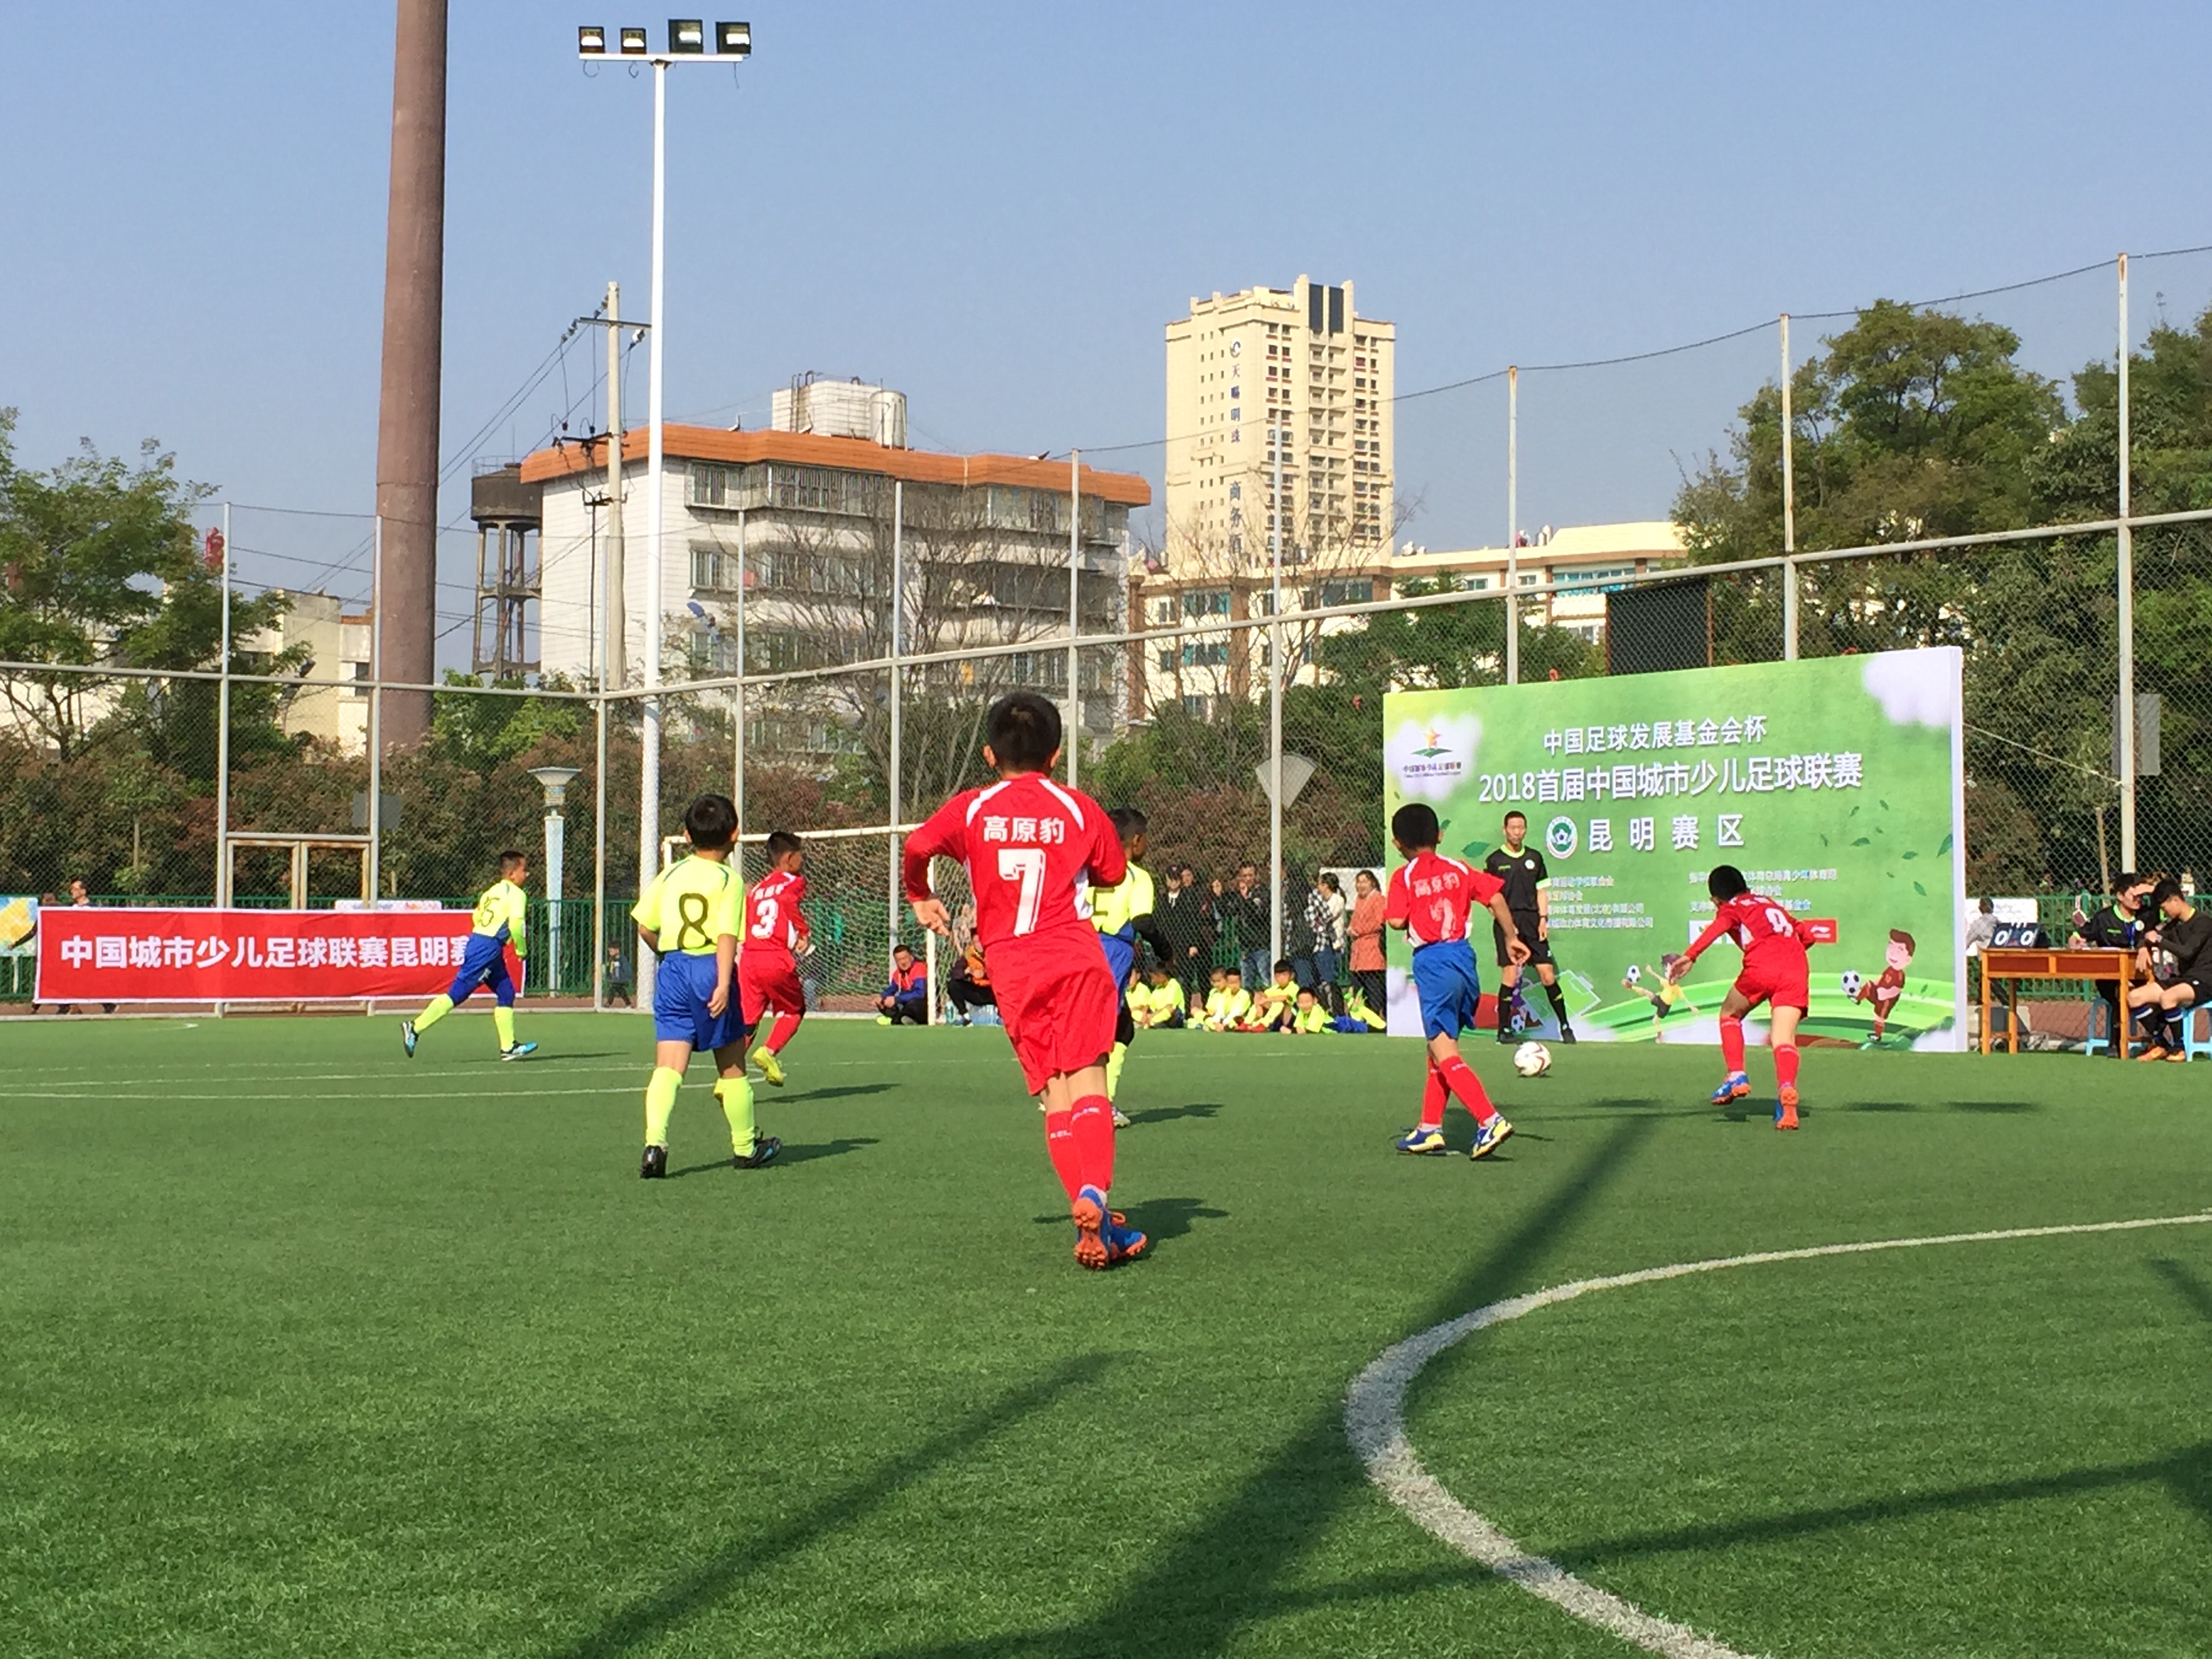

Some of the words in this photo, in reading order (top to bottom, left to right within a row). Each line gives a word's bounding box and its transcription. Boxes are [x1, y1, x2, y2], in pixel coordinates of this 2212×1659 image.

[1543, 714, 1767, 756] 中国足球发展基金会杯
[1478, 752, 1863, 802] 2018首届中国城市少儿足球联赛
[983, 815, 1065, 844] 高原豹
[1588, 814, 1745, 852] 昆明赛区
[998, 848, 1046, 937] 7
[678, 893, 716, 950] 8
[751, 898, 779, 939] 3
[1765, 907, 1794, 938] 9
[1994, 930, 2009, 945] 0
[2020, 930, 2034, 945] 0
[61, 935, 470, 968] 中国城市少儿足球联赛昆明赛
